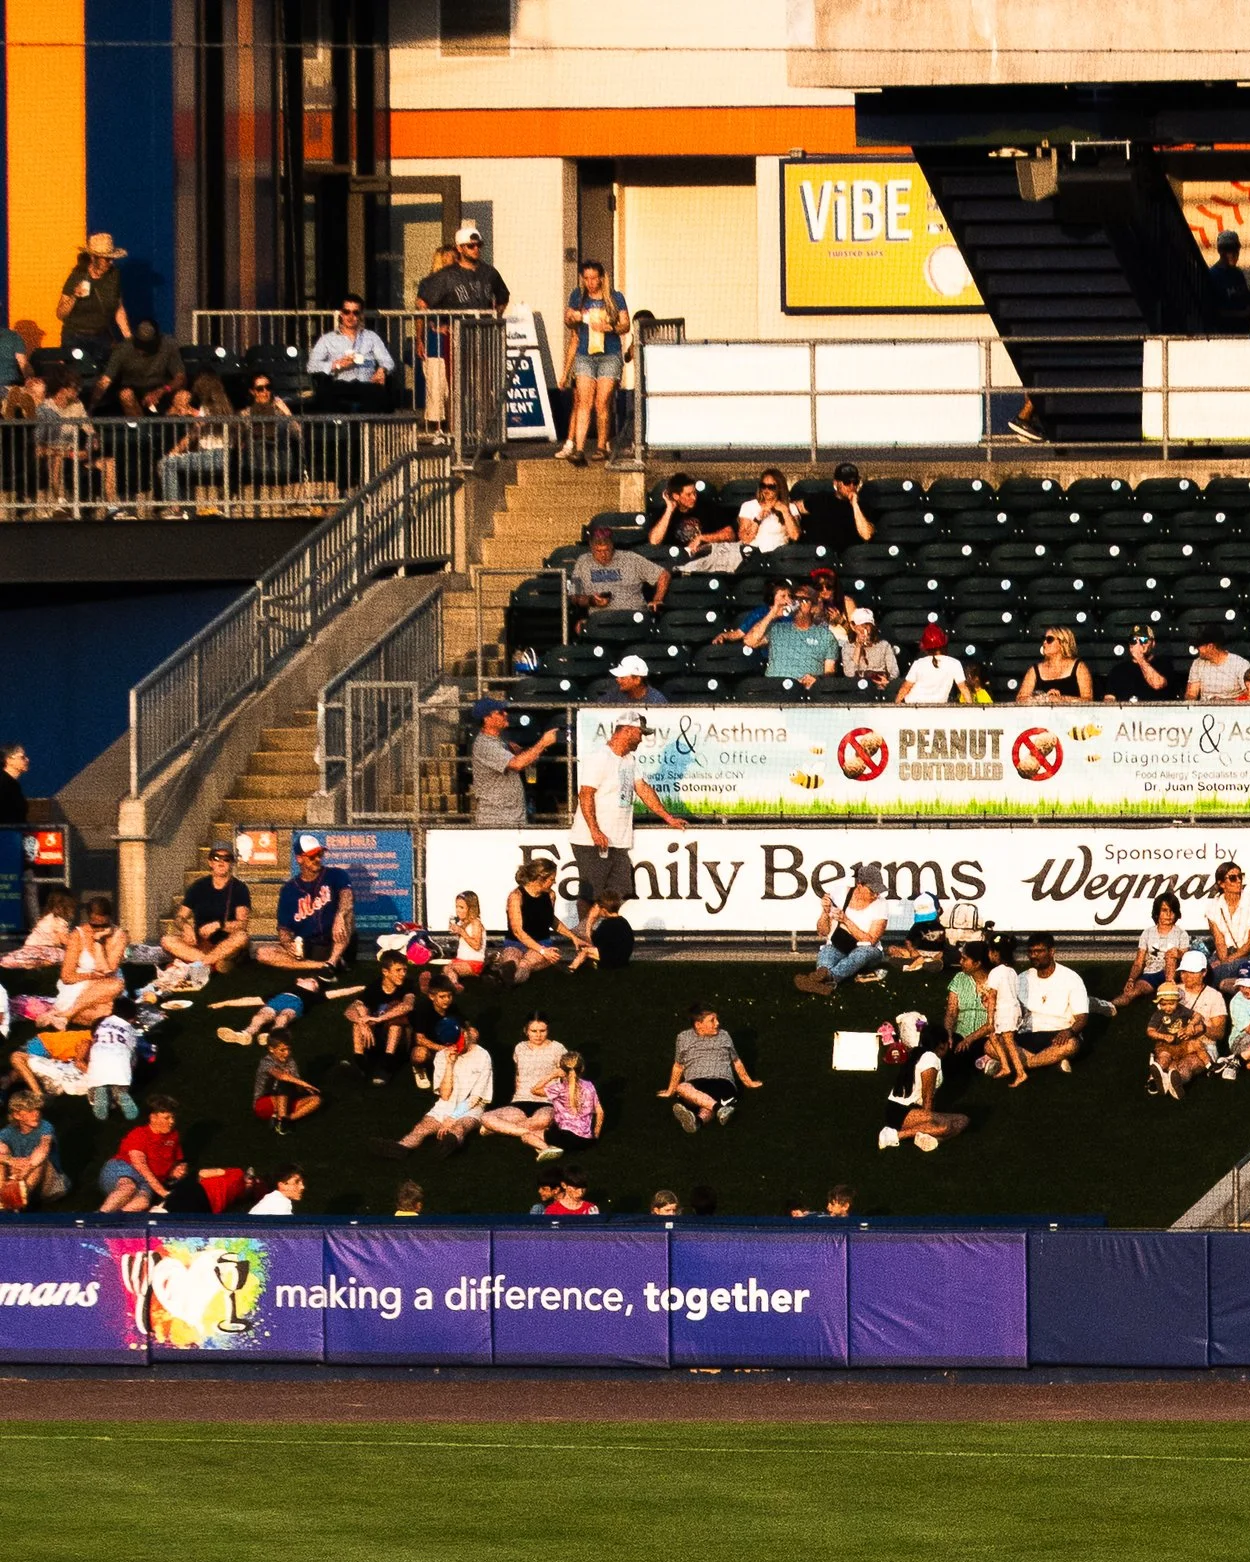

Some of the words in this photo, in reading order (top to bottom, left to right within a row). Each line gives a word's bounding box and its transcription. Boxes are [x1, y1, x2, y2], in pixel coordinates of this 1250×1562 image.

[507, 387, 538, 400] VATE
[592, 722, 671, 748] Algy
[703, 721, 788, 743] Asthma
[1114, 721, 1193, 748] Allergy
[1199, 713, 1221, 754] &
[898, 728, 1004, 760] PEANUT
[719, 751, 768, 765] Office
[1113, 751, 1200, 767] Diagnostic
[725, 770, 745, 780] CNY
[898, 761, 1004, 782] CONTROLLED
[1135, 770, 1157, 780] Food
[1160, 770, 1188, 781] Allergy
[1191, 769, 1238, 781] Specialists
[673, 781, 737, 794] Sotomayor
[1144, 781, 1161, 792] Dr.
[1165, 781, 1194, 792] Juan
[1104, 843, 1207, 864] Sponsored
[1215, 843, 1238, 863] by
[0, 1280, 99, 1308] mans
[275, 1275, 402, 1320] making
[413, 1286, 433, 1310] a
[444, 1274, 635, 1317] difference,
[643, 1277, 811, 1321] together
